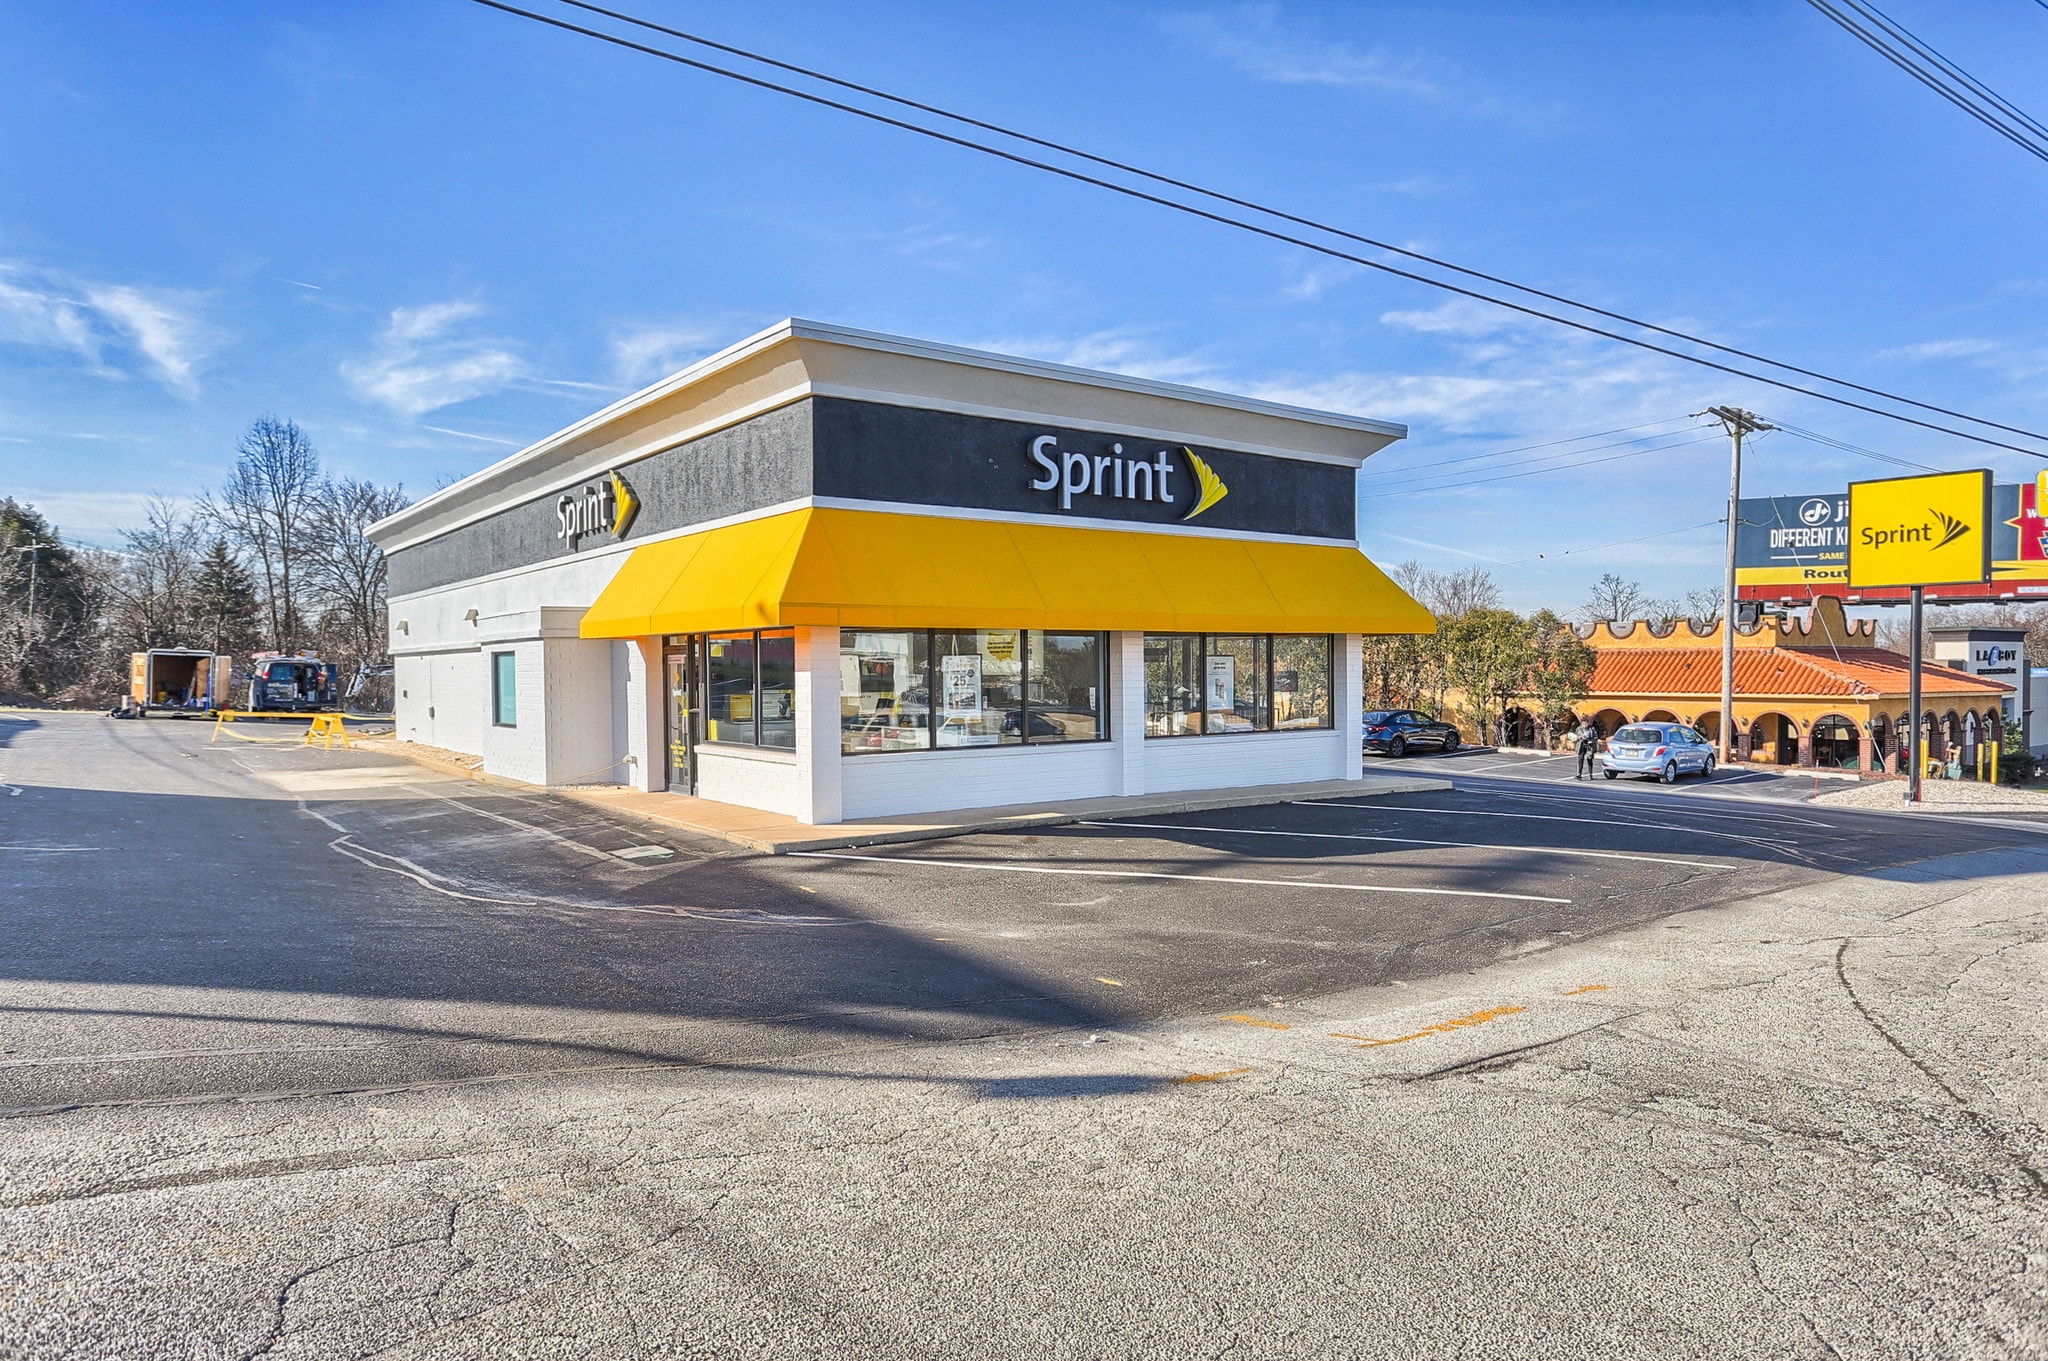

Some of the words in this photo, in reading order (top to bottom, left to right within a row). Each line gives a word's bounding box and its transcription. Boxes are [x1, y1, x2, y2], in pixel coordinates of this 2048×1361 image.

[1028, 435, 1174, 509] Sprint
[557, 481, 610, 549] Sprint
[1770, 527, 1833, 548] DIFFERENT
[1861, 523, 1932, 549] Sprint
[1818, 552, 1845, 560] SAME
